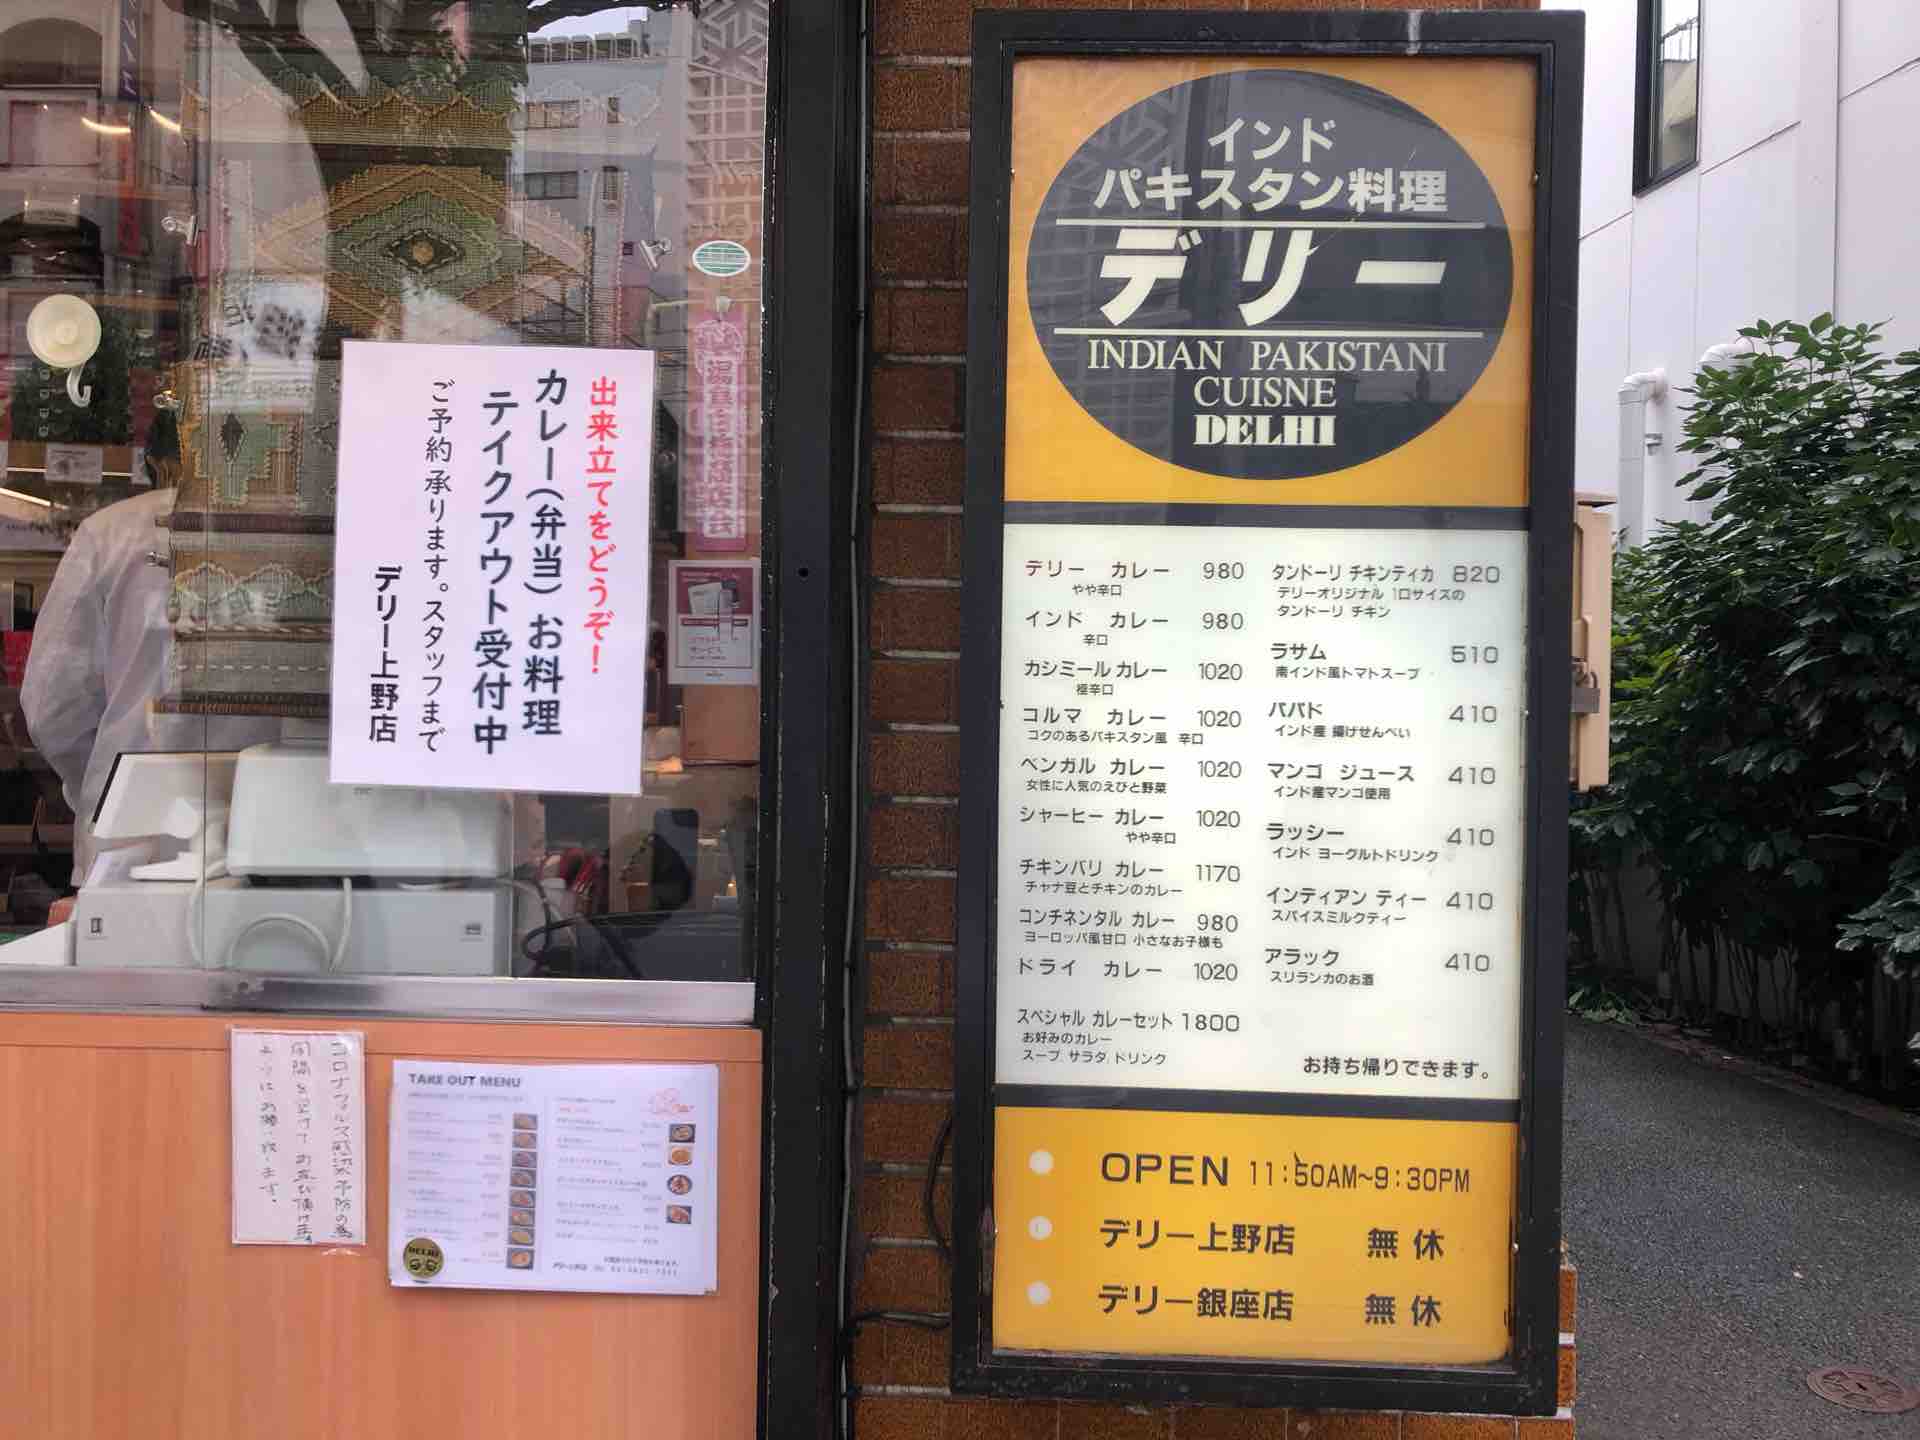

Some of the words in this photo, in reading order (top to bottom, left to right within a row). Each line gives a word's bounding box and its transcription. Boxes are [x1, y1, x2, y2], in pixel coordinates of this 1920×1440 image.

[1207, 117, 1337, 164] インド
[1093, 165, 1448, 214] パキスタン料理
[1099, 228, 1446, 327] デリー
[1087, 338, 1225, 370] INDIAN
[1249, 340, 1447, 372] PAKISTANI
[1193, 375, 1337, 408] CUISNE
[1193, 414, 1337, 446] DELHI
[417, 379, 455, 753] ご予約承ります。スタッフまで
[472, 390, 519, 756] テイクアウト受付中
[1111, 561, 1169, 579] カレー
[1202, 561, 1245, 580] 980
[1272, 563, 1342, 582] タンドーリ
[1348, 564, 1434, 583] チキンティカ
[1452, 565, 1501, 584] 820
[1071, 583, 1122, 597] やや辛口
[1025, 610, 1082, 629] インド
[1109, 611, 1169, 629] カレー
[1202, 612, 1244, 631] 980
[1351, 605, 1391, 618] チキン
[1082, 633, 1108, 646] 辛口
[368, 565, 402, 744] デリー上野店
[1270, 642, 1327, 661] ラサム
[1450, 645, 1499, 665] 510
[1024, 659, 1112, 678] カシミール
[1116, 660, 1168, 679] カレー
[1198, 662, 1243, 681] 1020
[1023, 706, 1082, 724] コルマ
[1107, 708, 1166, 726] カレー
[1196, 709, 1242, 729] 1020
[1448, 704, 1497, 724] 410
[1178, 732, 1204, 745] 辛口
[1020, 757, 1096, 775] ベンガル
[1110, 758, 1165, 776] カレー
[1197, 760, 1242, 779] 1020
[1267, 762, 1323, 780] マンゴ
[1340, 764, 1415, 782] ジュース
[1447, 766, 1496, 785] 410
[1019, 806, 1104, 824] シャーヒー
[1114, 807, 1165, 826] カレー
[1196, 809, 1241, 829] 1020
[1125, 831, 1176, 845] やや辛口
[1265, 822, 1345, 842] ラッシー
[1445, 827, 1495, 847] 410
[1272, 846, 1311, 860] インド
[1114, 860, 1164, 879] カレー
[1195, 864, 1241, 883] 1170
[1375, 889, 1427, 908] ティー
[1445, 891, 1494, 911] 410
[1019, 908, 1123, 928] コンチネンタル
[1131, 911, 1175, 929] カレー
[1197, 913, 1239, 933] 980
[1019, 957, 1077, 977] ドライ
[1103, 959, 1163, 979] カレー
[1193, 962, 1239, 982] 1020
[1264, 948, 1340, 967] アラック
[1444, 952, 1491, 973] 410
[1092, 1009, 1173, 1030] カレーセット
[1181, 1012, 1240, 1033] 1800
[1021, 1031, 1113, 1046] お好みのカレー
[1303, 1055, 1489, 1080] お持ち帰りできます。
[407, 1073, 443, 1087] TAKE
[447, 1074, 477, 1087] OUT
[479, 1075, 521, 1088] MENU
[1101, 1152, 1229, 1187] OPEN
[1099, 1219, 1296, 1257] デリー上野店
[1097, 1284, 1294, 1322] デリー銀座店
